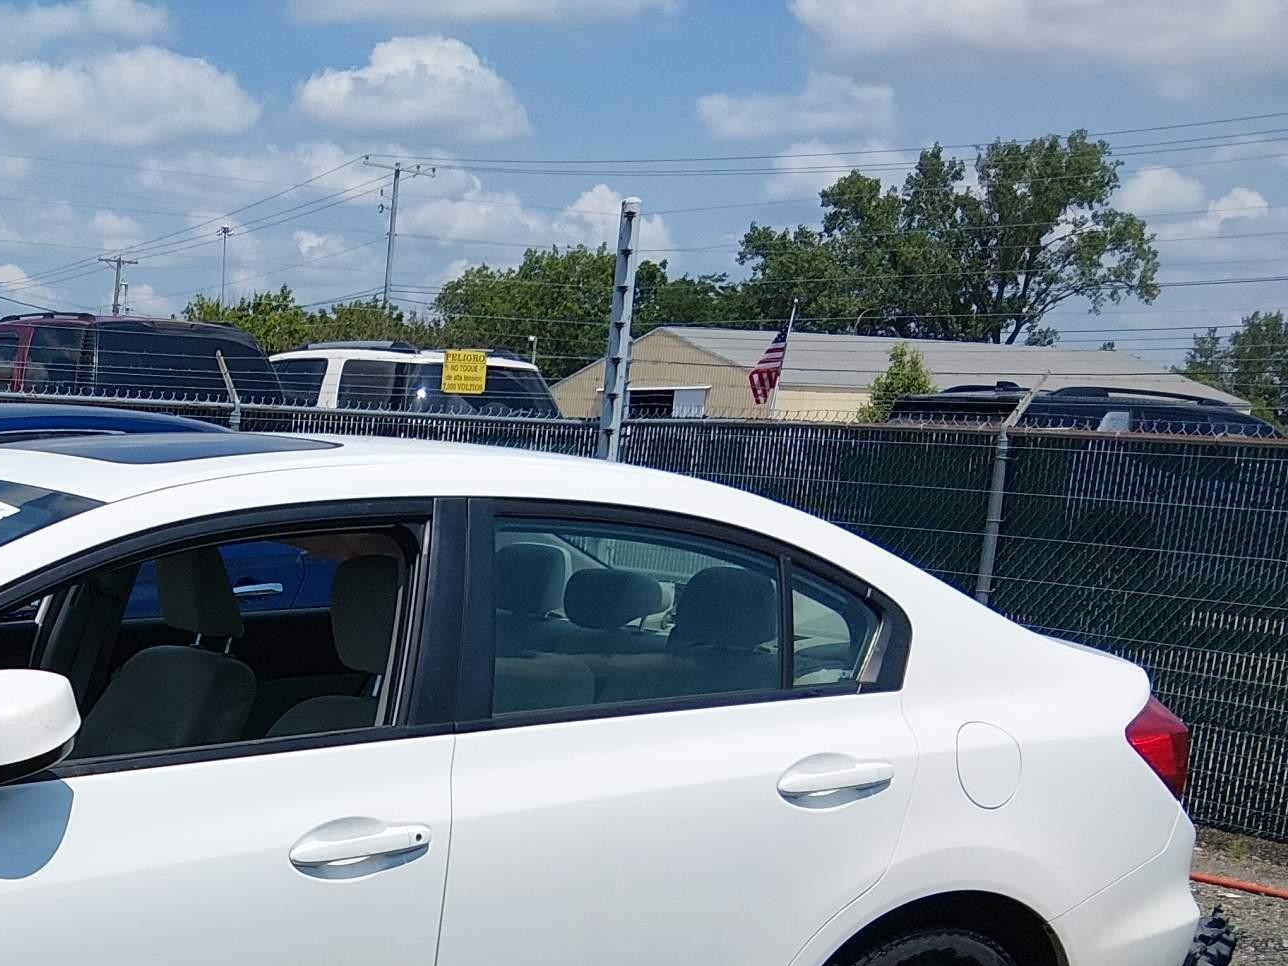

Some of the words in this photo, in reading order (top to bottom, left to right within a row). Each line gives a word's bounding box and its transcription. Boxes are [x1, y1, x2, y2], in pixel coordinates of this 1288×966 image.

[445, 352, 486, 363] PELIGRO
[451, 364, 459, 372] NO
[460, 364, 479, 373] TOQUE
